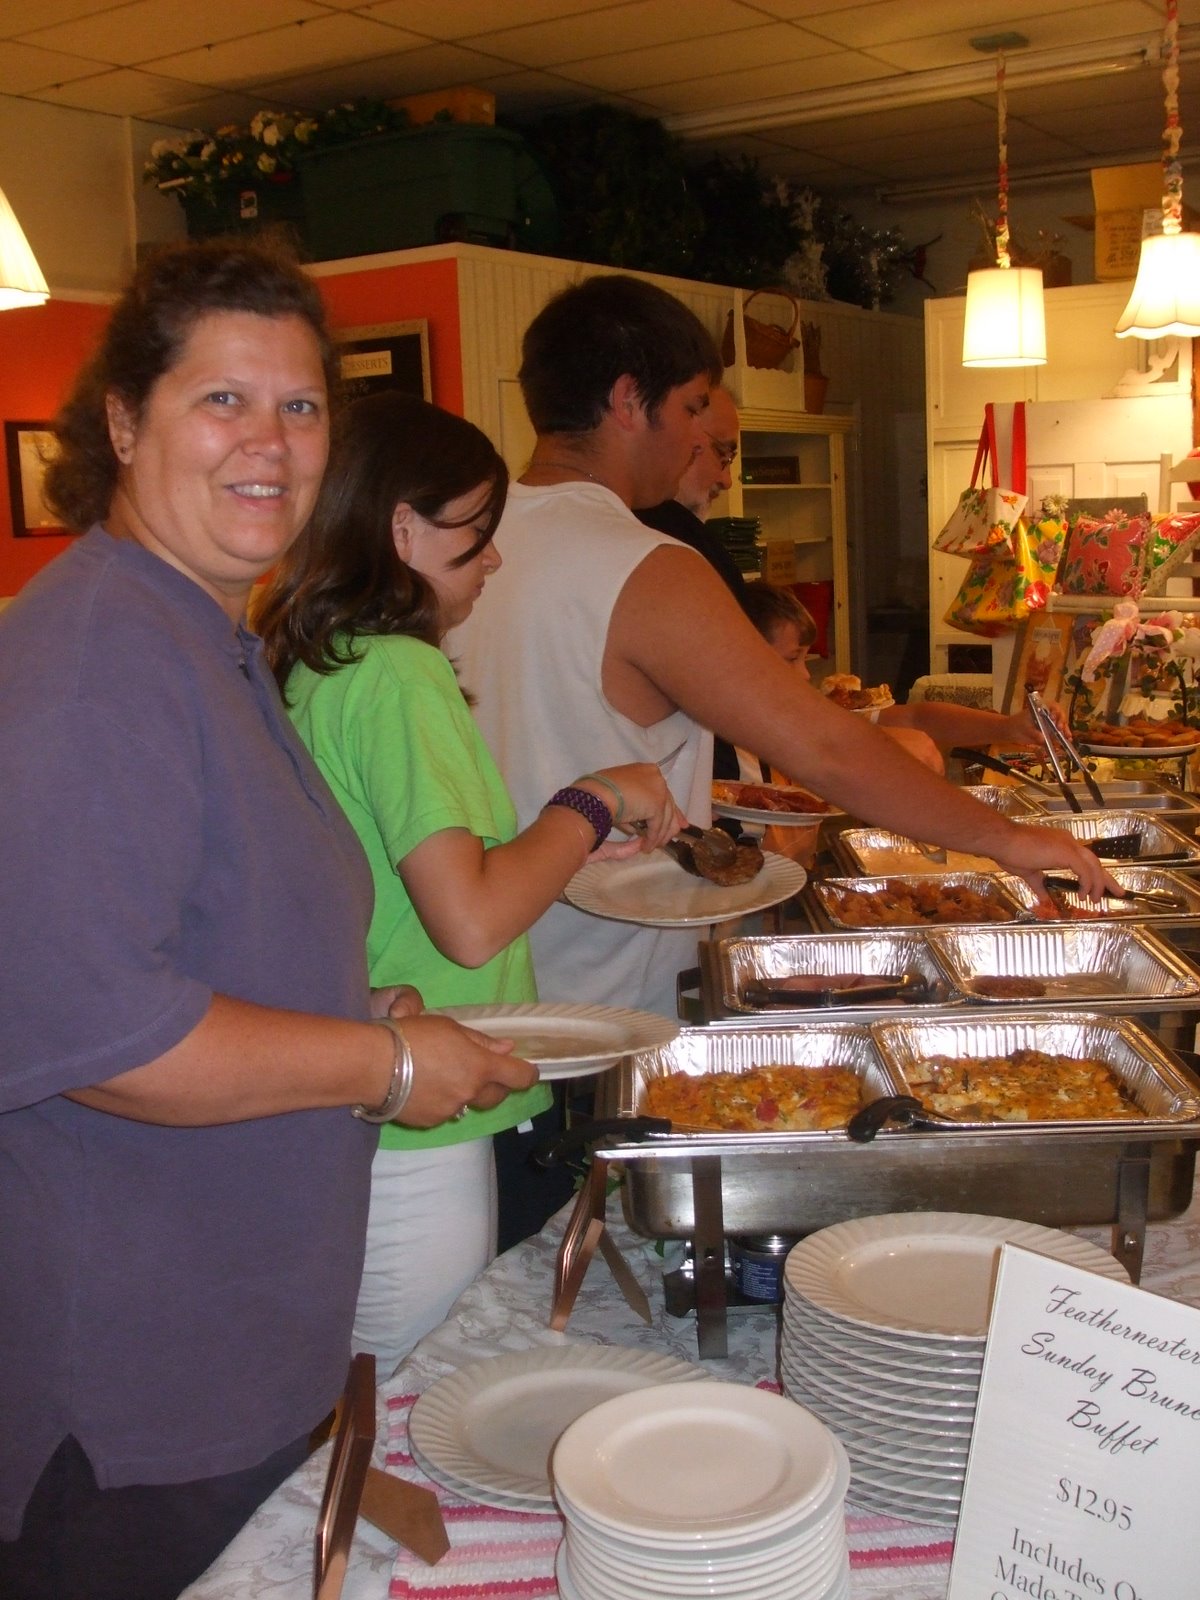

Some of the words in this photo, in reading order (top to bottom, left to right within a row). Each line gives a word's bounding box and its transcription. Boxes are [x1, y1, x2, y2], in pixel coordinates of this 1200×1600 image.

[346, 358, 389, 371] ESSERTS
[1020, 1331, 1114, 1392] Sunday
[1066, 1399, 1160, 1455] Buffet
[1056, 1476, 1133, 1531] $12.95
[1012, 1527, 1106, 1595] Includes
